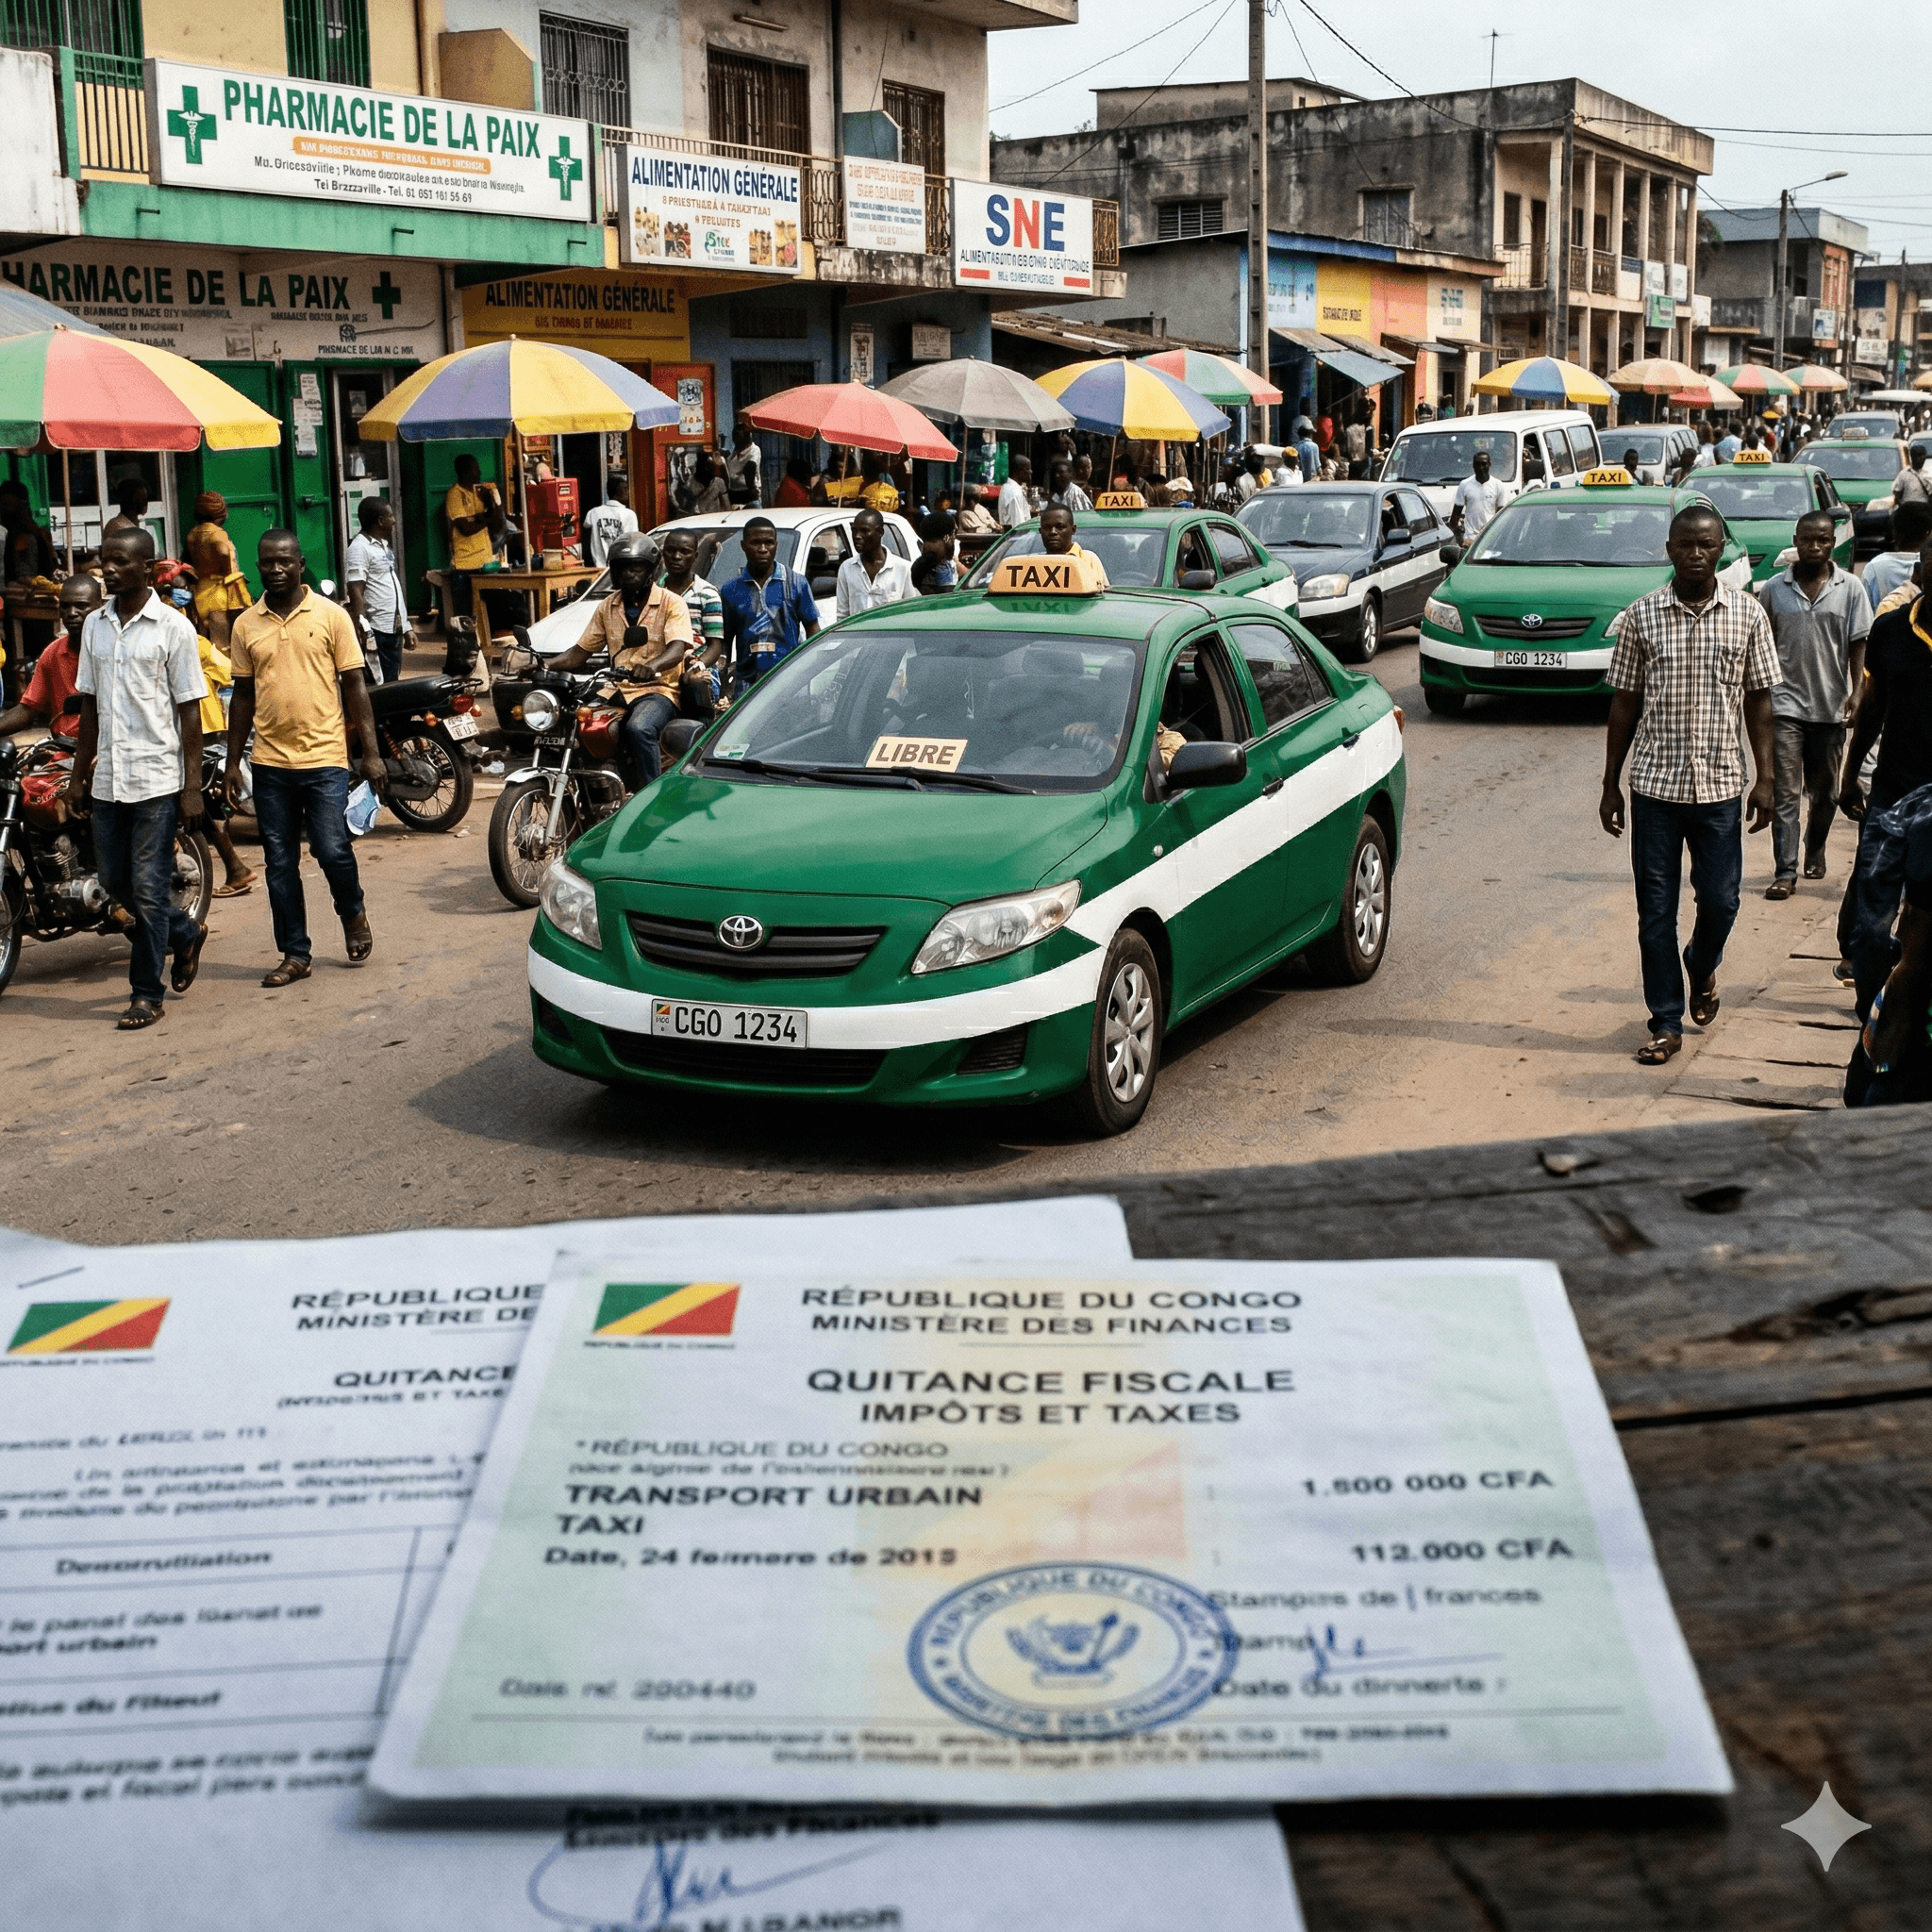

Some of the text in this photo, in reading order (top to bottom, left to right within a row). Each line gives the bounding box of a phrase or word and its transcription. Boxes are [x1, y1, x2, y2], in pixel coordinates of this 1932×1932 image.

[224, 79, 394, 141] PHARMACIE
[404, 105, 438, 146] DE
[446, 110, 478, 151] LA
[487, 115, 541, 158] PAIX
[632, 157, 798, 203] ALIMENTATION GÉNÉRALE
[986, 193, 1065, 252] SNE
[2, 261, 351, 309] HARMACIE DE LA PAIX
[485, 279, 675, 313] ALIMENTATION GÉNÉRALE
[1739, 453, 1765, 462] TAXI
[1590, 472, 1623, 483] TAXI
[1102, 495, 1134, 507] TAXI
[1006, 565, 1070, 588] TAXI
[1506, 652, 1562, 666] CGO 1234
[875, 742, 957, 765] LIBRE
[675, 1007, 797, 1042] CGO 1234
[291, 1284, 545, 1309] RÉPUBLIQUE
[801, 1285, 1302, 1308] RÉPUBLIQUE DU CONGO
[296, 1307, 486, 1331] MINISTÈRE
[811, 1312, 1293, 1335] MINISTÈRE DES FINANCES
[808, 1369, 1296, 1394] QUITANCE FISCALE
[859, 1400, 1241, 1424] IMPÔTS ET TAXES
[787, 1441, 828, 1457] DU
[837, 1441, 949, 1458] CONGO
[1478, 1469, 1555, 1490] CFA
[563, 1484, 983, 1507] TRANSPORT URBAIN
[556, 1513, 644, 1536] TAXI
[543, 1546, 628, 1568] Date,
[640, 1547, 678, 1566] 24
[826, 1547, 868, 1566] de
[1496, 1538, 1574, 1560] CFA
